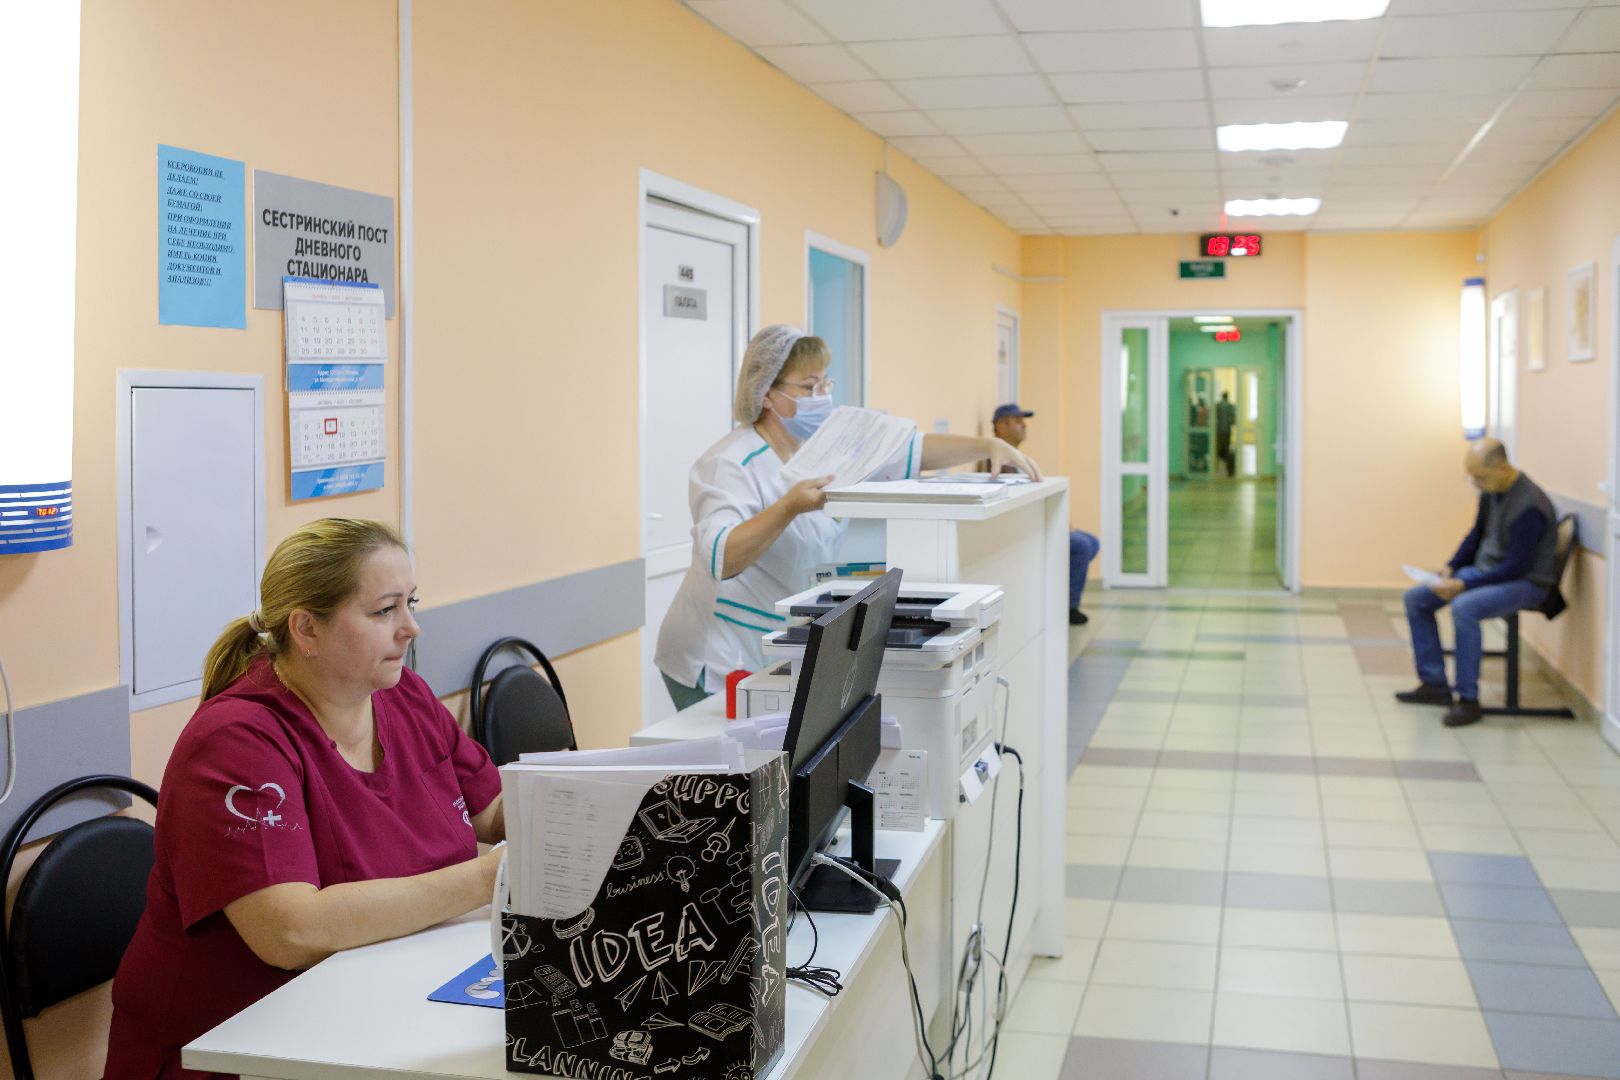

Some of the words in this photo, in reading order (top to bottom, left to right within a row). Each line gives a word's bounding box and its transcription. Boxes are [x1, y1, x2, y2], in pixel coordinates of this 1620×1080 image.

[168, 160, 213, 175] КСЕРОКОПИИ
[167, 186, 187, 196] ДАЖЕ
[262, 208, 354, 239] СЕСТРИНСКИЙ
[358, 225, 388, 244] ПОСТ
[295, 237, 361, 261] ДНЕВНОГО
[287, 259, 369, 283] СТАЦИОНАРА
[605, 871, 665, 900] business
[761, 852, 782, 1008] IDEA
[569, 902, 718, 989] IDEA
[551, 995, 561, 1007] A
[506, 1033, 652, 1080] LANNIN
